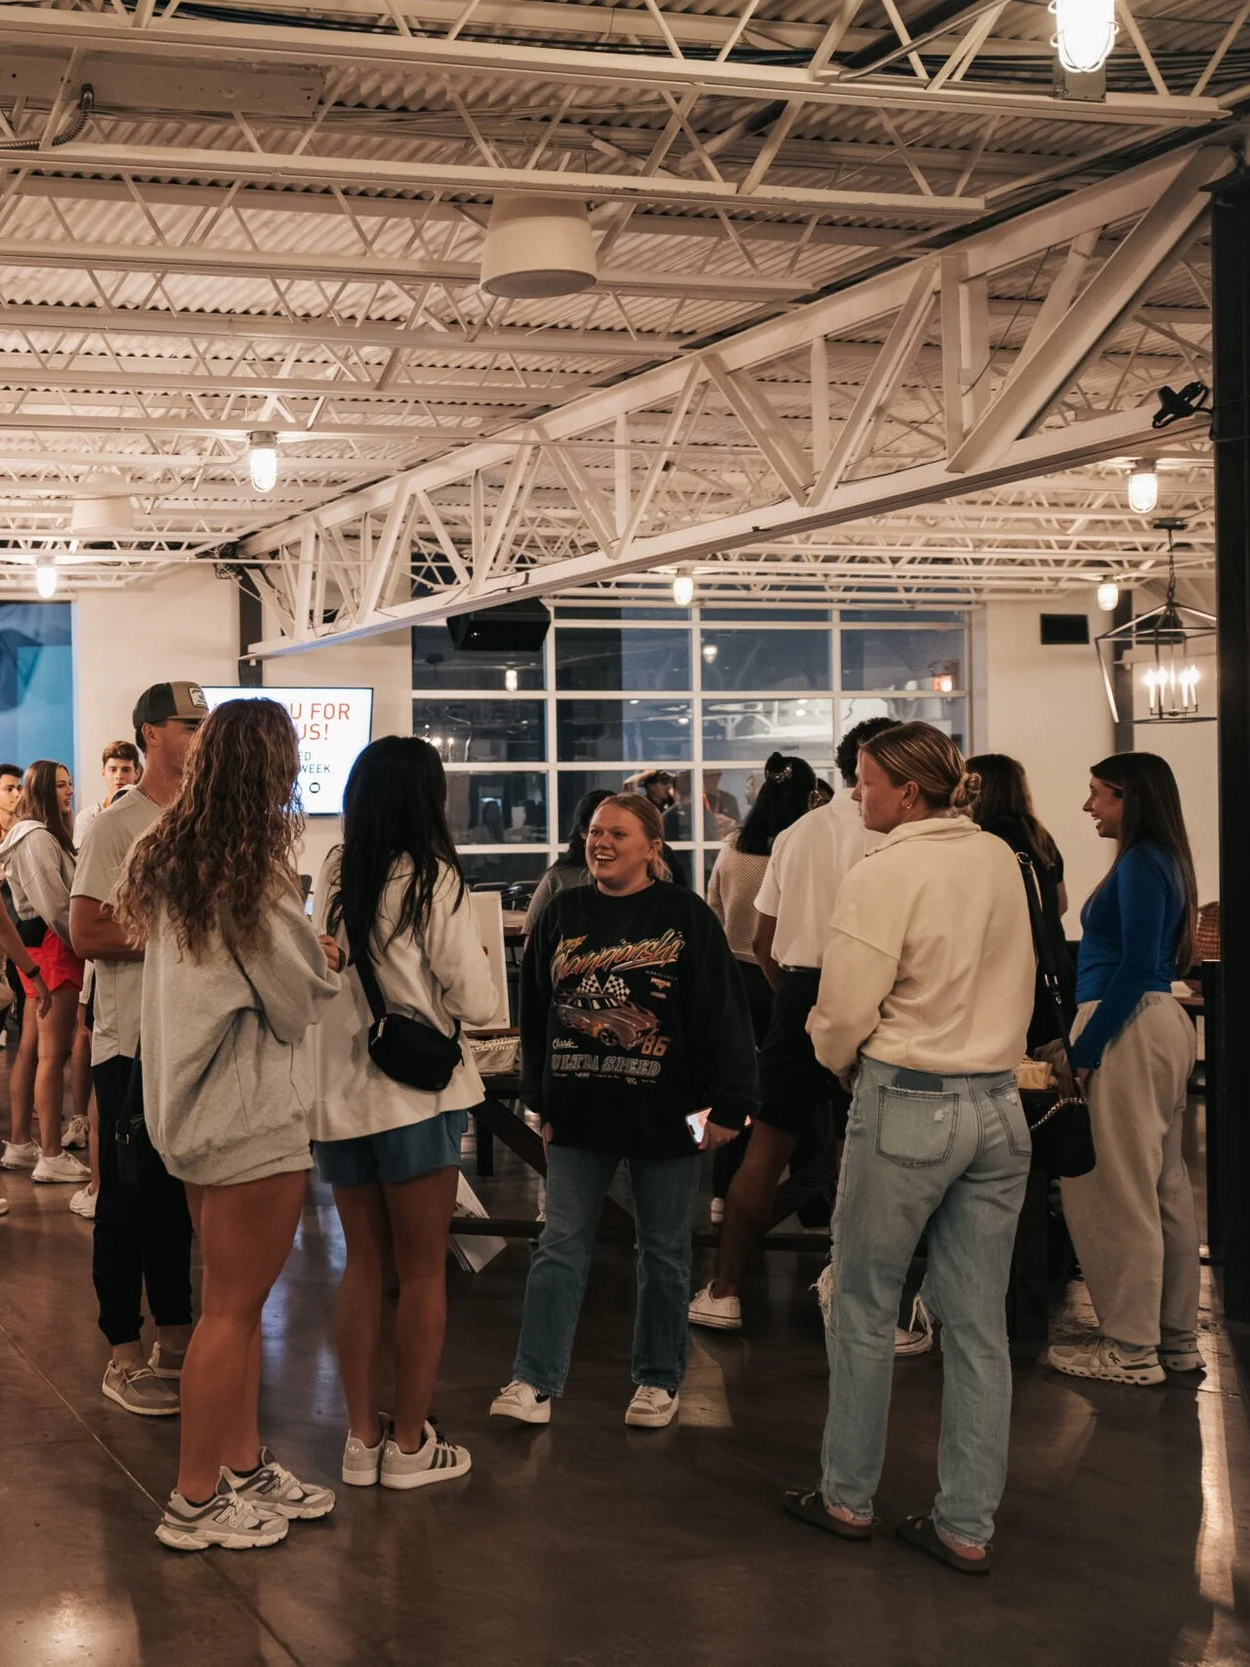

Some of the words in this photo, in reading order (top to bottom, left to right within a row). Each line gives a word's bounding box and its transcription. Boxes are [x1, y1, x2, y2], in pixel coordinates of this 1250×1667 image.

[310, 703, 351, 720] FOR
[551, 1053, 600, 1071] ULTRA
[601, 1055, 662, 1078] SPEED
